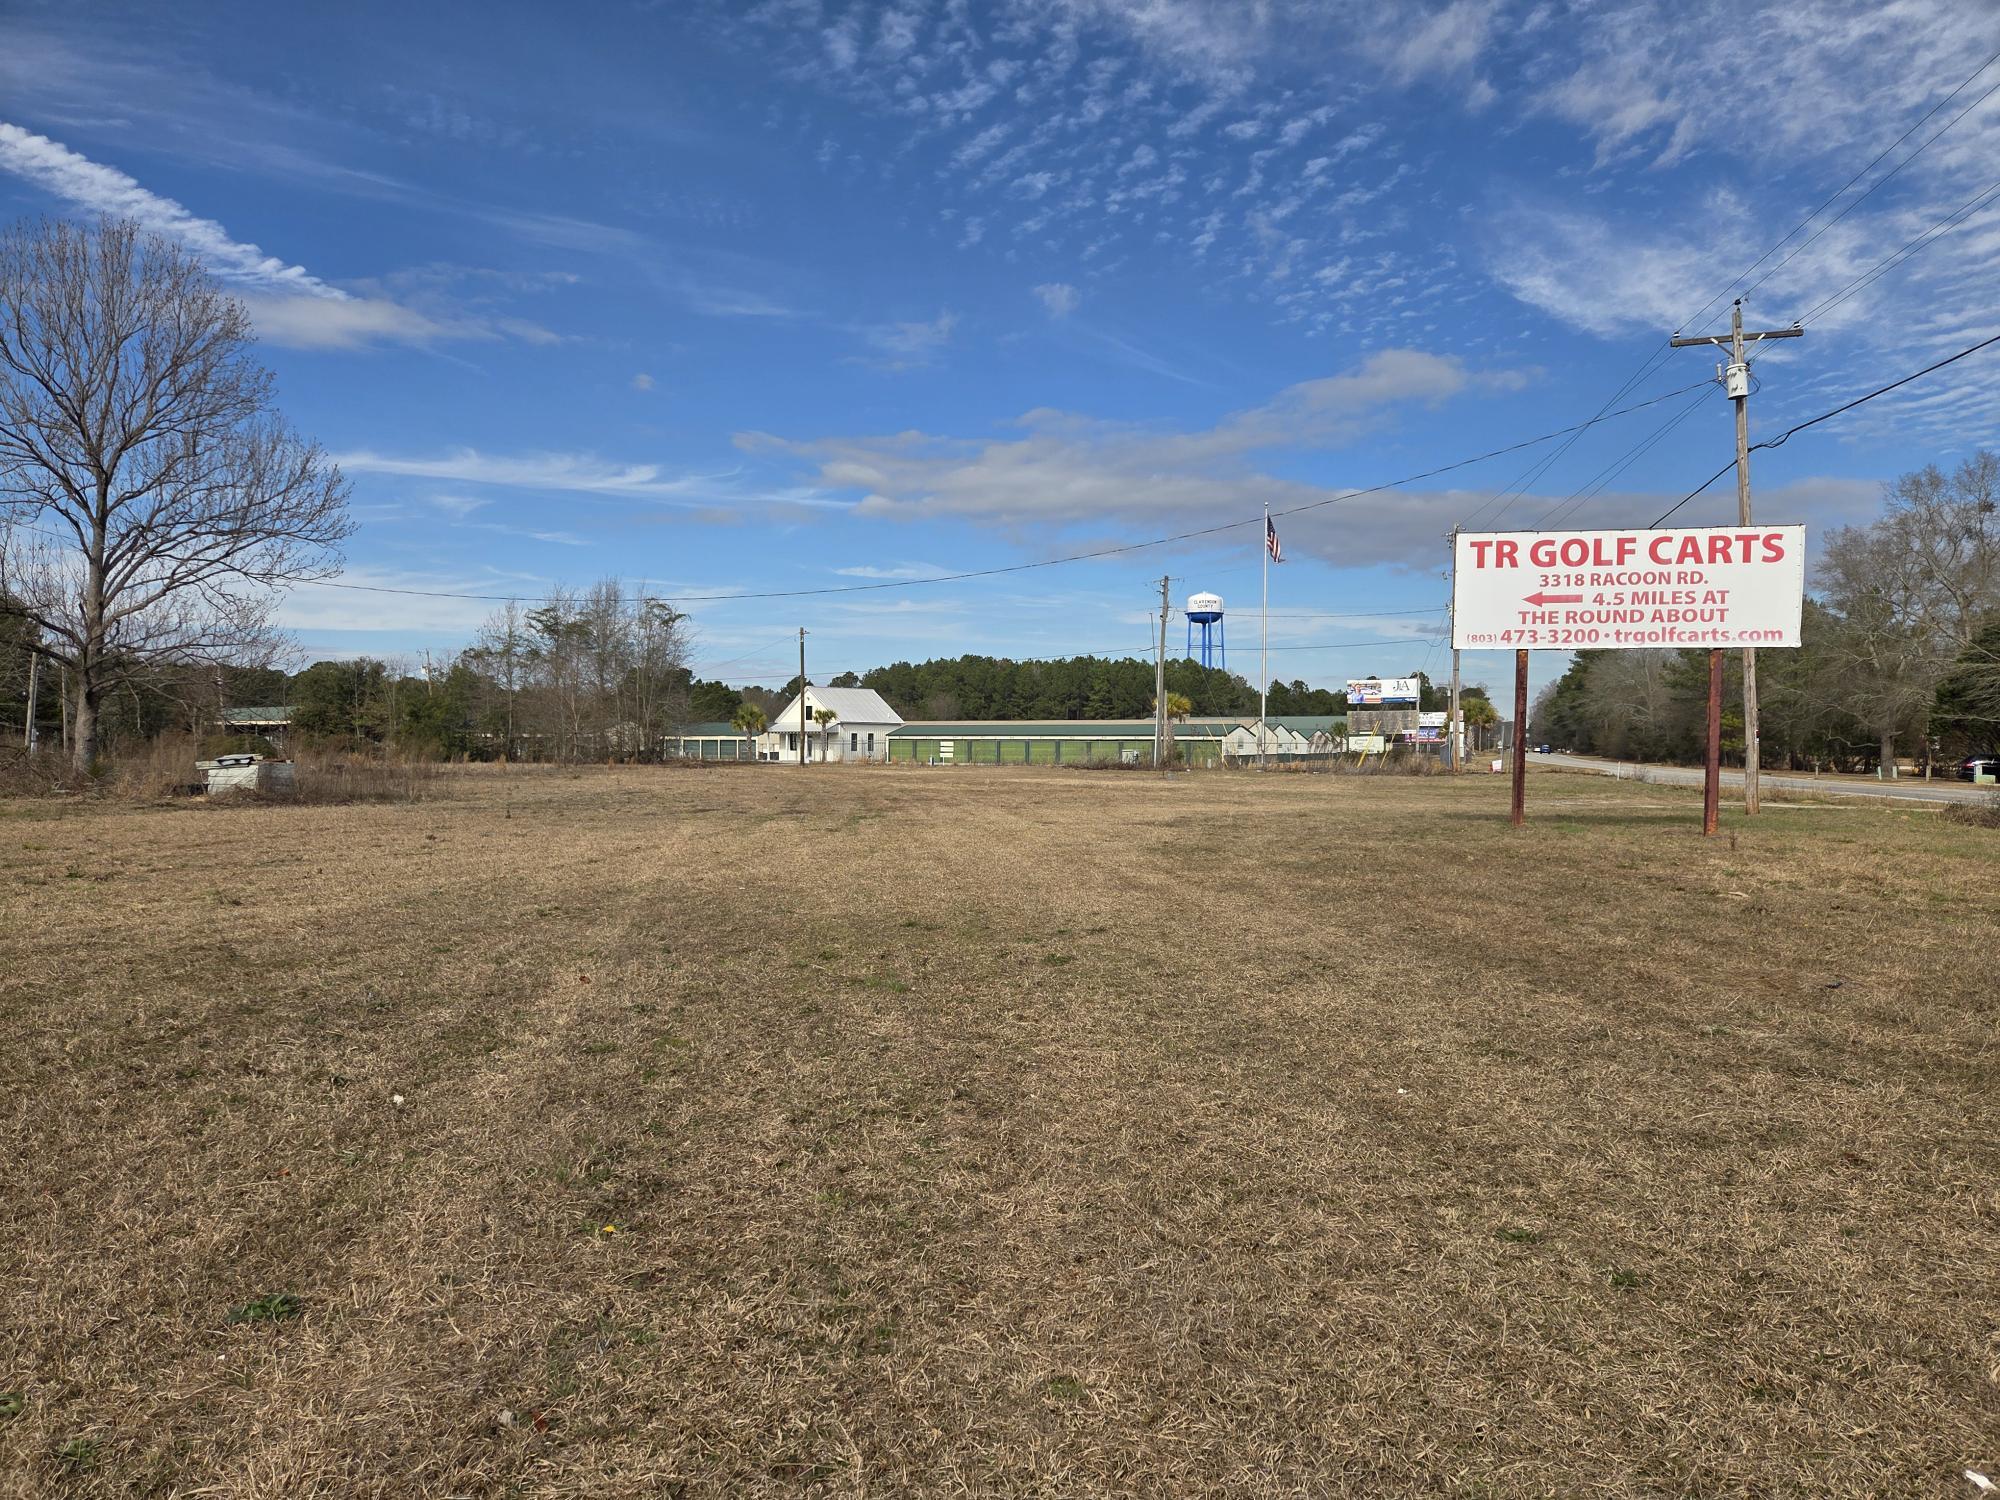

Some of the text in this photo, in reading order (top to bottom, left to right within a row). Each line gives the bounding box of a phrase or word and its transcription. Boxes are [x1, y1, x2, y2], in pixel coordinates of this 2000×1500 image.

[1470, 533, 1785, 569] TR GOLF CARTS
[1539, 570, 1709, 587] 3318 RACOON RD.
[1592, 590, 1730, 606] 4.5 MILES AT
[1518, 608, 1729, 625] THE ROUND ABOUT
[1467, 627, 1784, 645] (803) 473-3200 trgolfcarts.com
